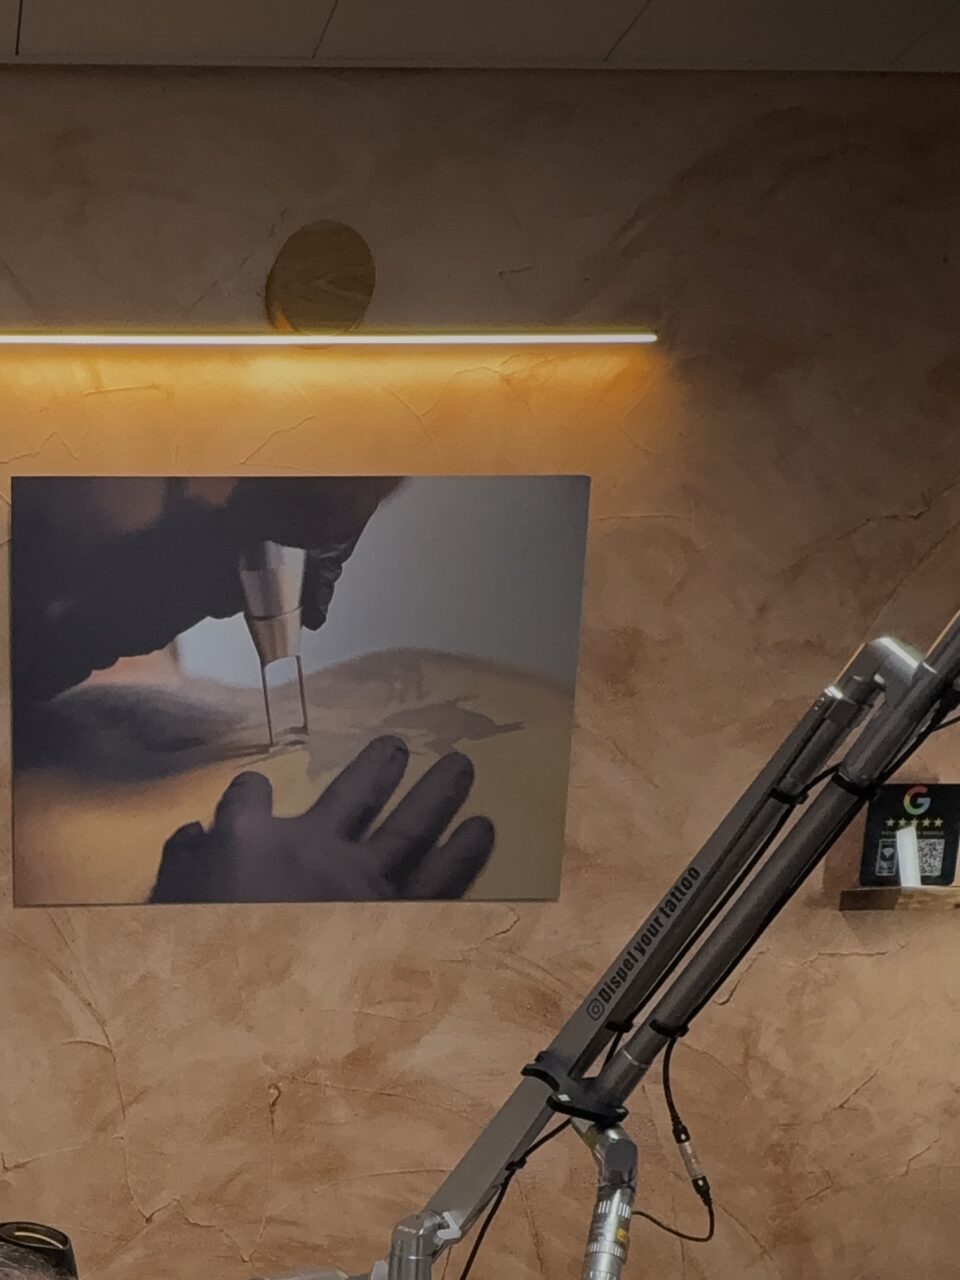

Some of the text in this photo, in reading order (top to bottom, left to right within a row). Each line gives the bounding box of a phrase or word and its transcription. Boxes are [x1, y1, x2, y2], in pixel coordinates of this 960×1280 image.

[598, 866, 701, 1004] Dispel your tattoo
